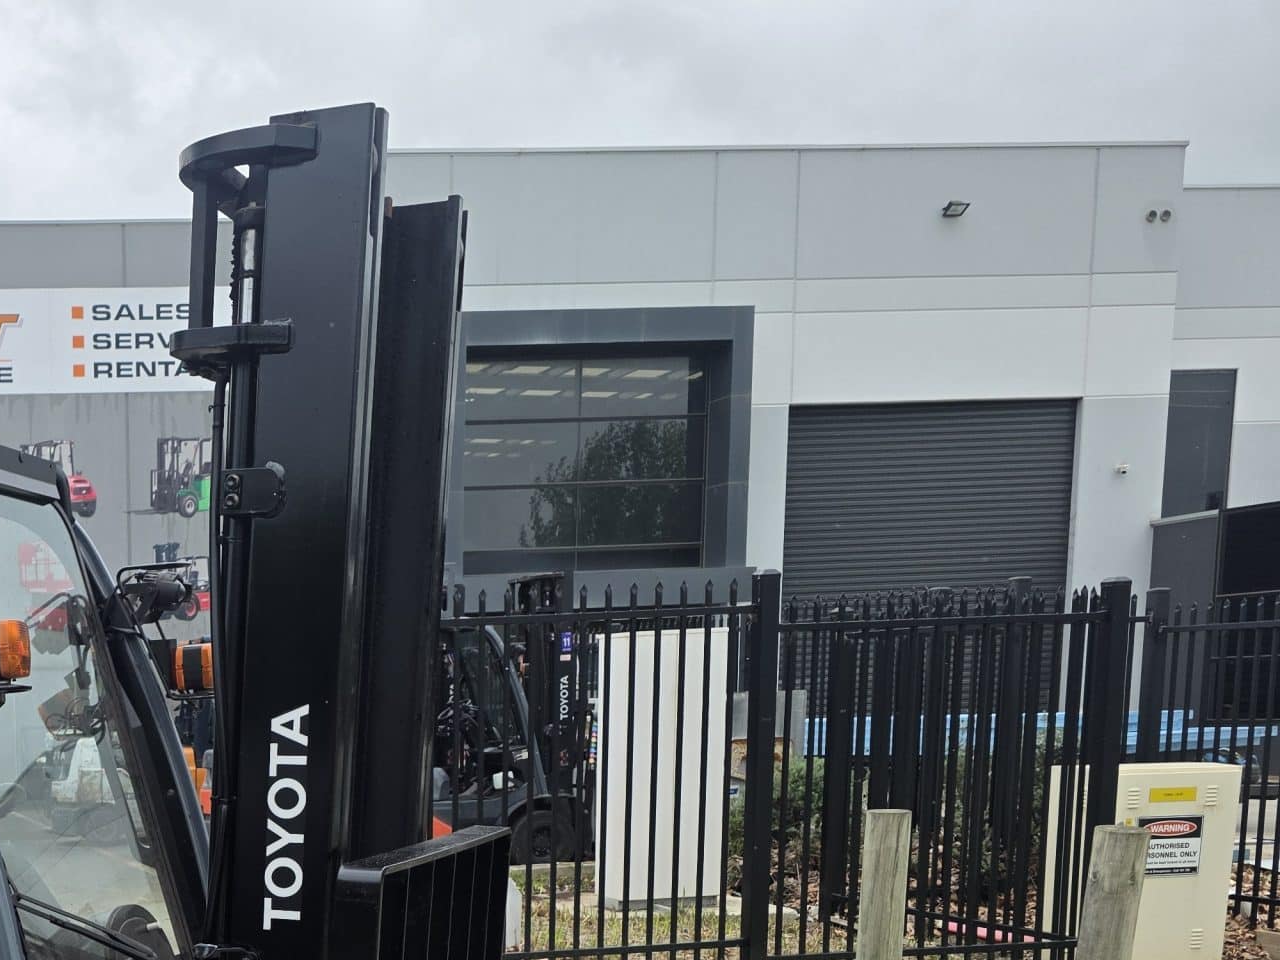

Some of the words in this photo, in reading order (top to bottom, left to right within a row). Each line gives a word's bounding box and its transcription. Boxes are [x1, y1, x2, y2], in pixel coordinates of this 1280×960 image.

[92, 304, 190, 321] SALES
[92, 332, 170, 349] SERV
[93, 361, 188, 378] RENTA
[560, 675, 569, 721] TOYOTA
[262, 703, 310, 930] TOYOTA
[1150, 823, 1190, 833] WARNING
